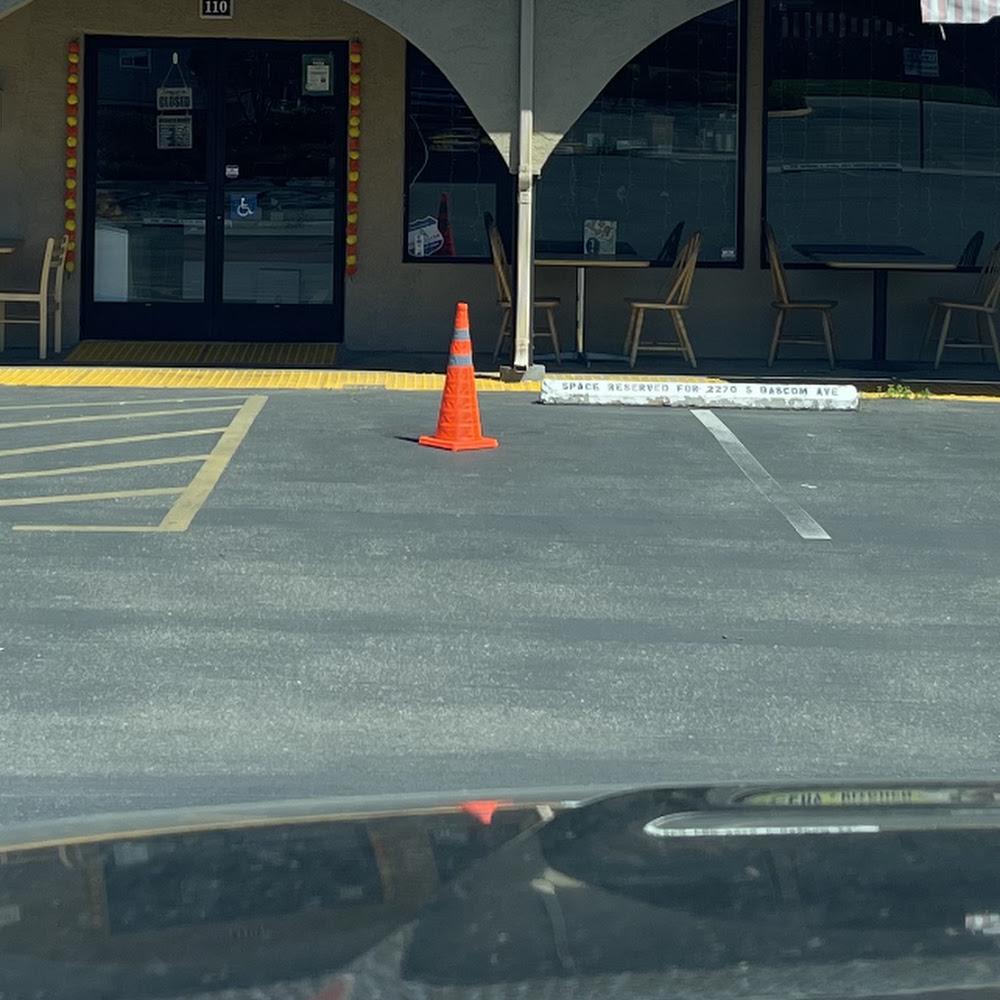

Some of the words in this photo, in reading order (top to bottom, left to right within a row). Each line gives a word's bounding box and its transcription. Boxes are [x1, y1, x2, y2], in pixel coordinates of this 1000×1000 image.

[205, 0, 228, 13] 110
[561, 382, 599, 391] SPACE
[608, 383, 669, 392] RESERVED
[676, 384, 699, 393] FOR
[705, 385, 738, 394] 2270
[816, 387, 839, 396] AVE
